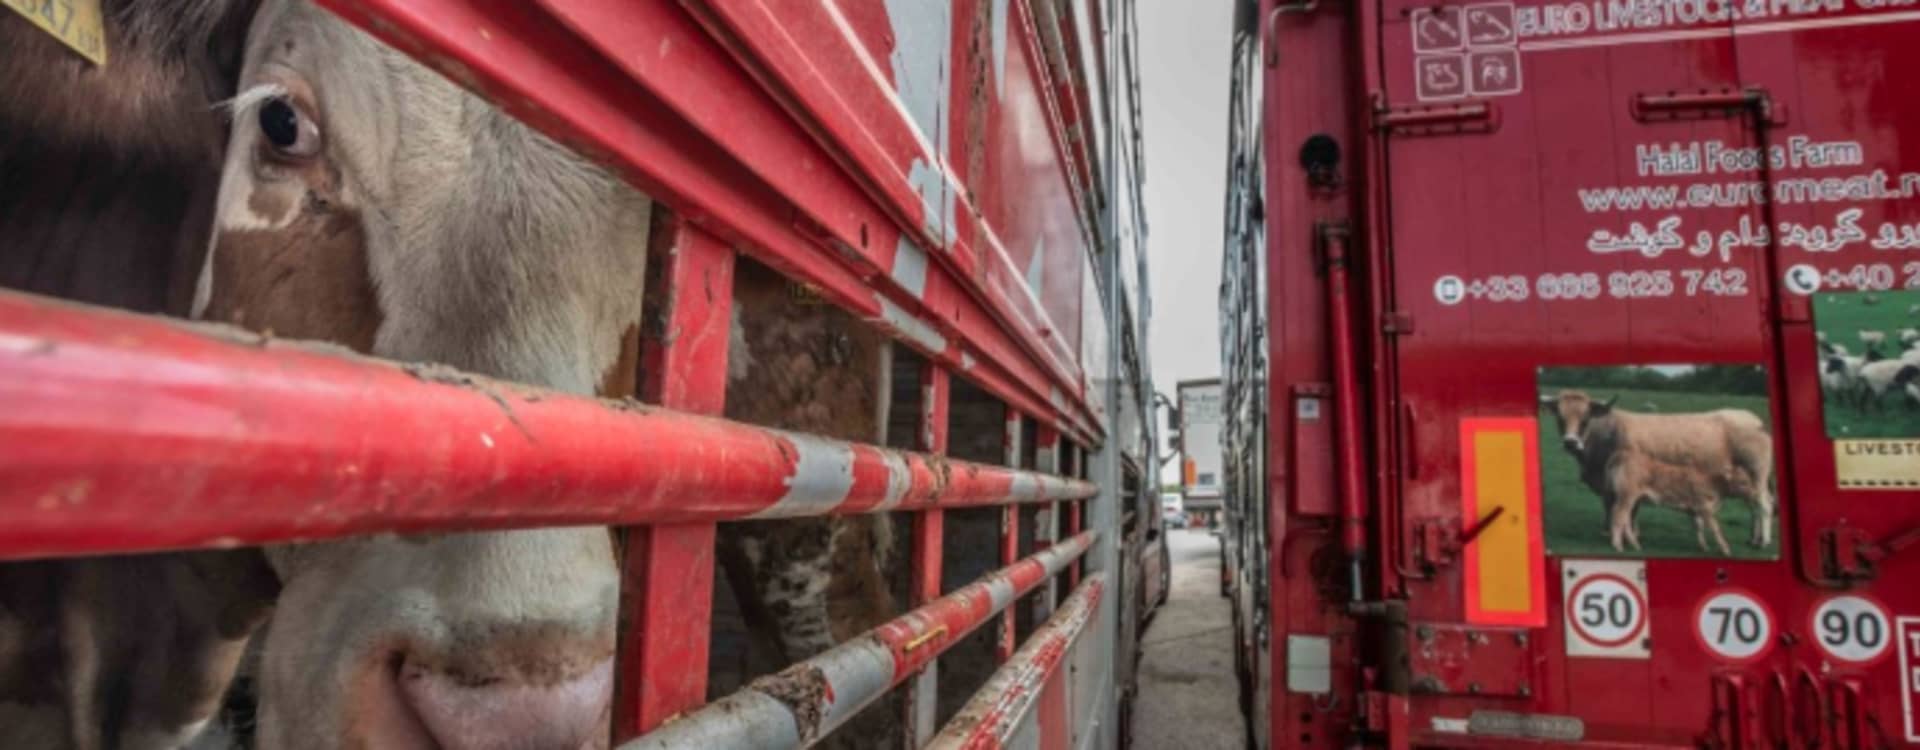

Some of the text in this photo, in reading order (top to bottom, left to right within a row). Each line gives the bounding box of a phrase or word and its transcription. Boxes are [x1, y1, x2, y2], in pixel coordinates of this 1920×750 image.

[1518, 4, 1591, 36] EURO
[1594, 0, 1741, 30] LIVESTOCK
[1636, 142, 1701, 176] Halal
[1788, 135, 1863, 168] Farm
[1680, 268, 1749, 296] 742
[1845, 443, 1920, 456] LIVEST
[1581, 593, 1632, 628] 50
[1709, 607, 1760, 643] 70
[1822, 611, 1882, 648] 90
